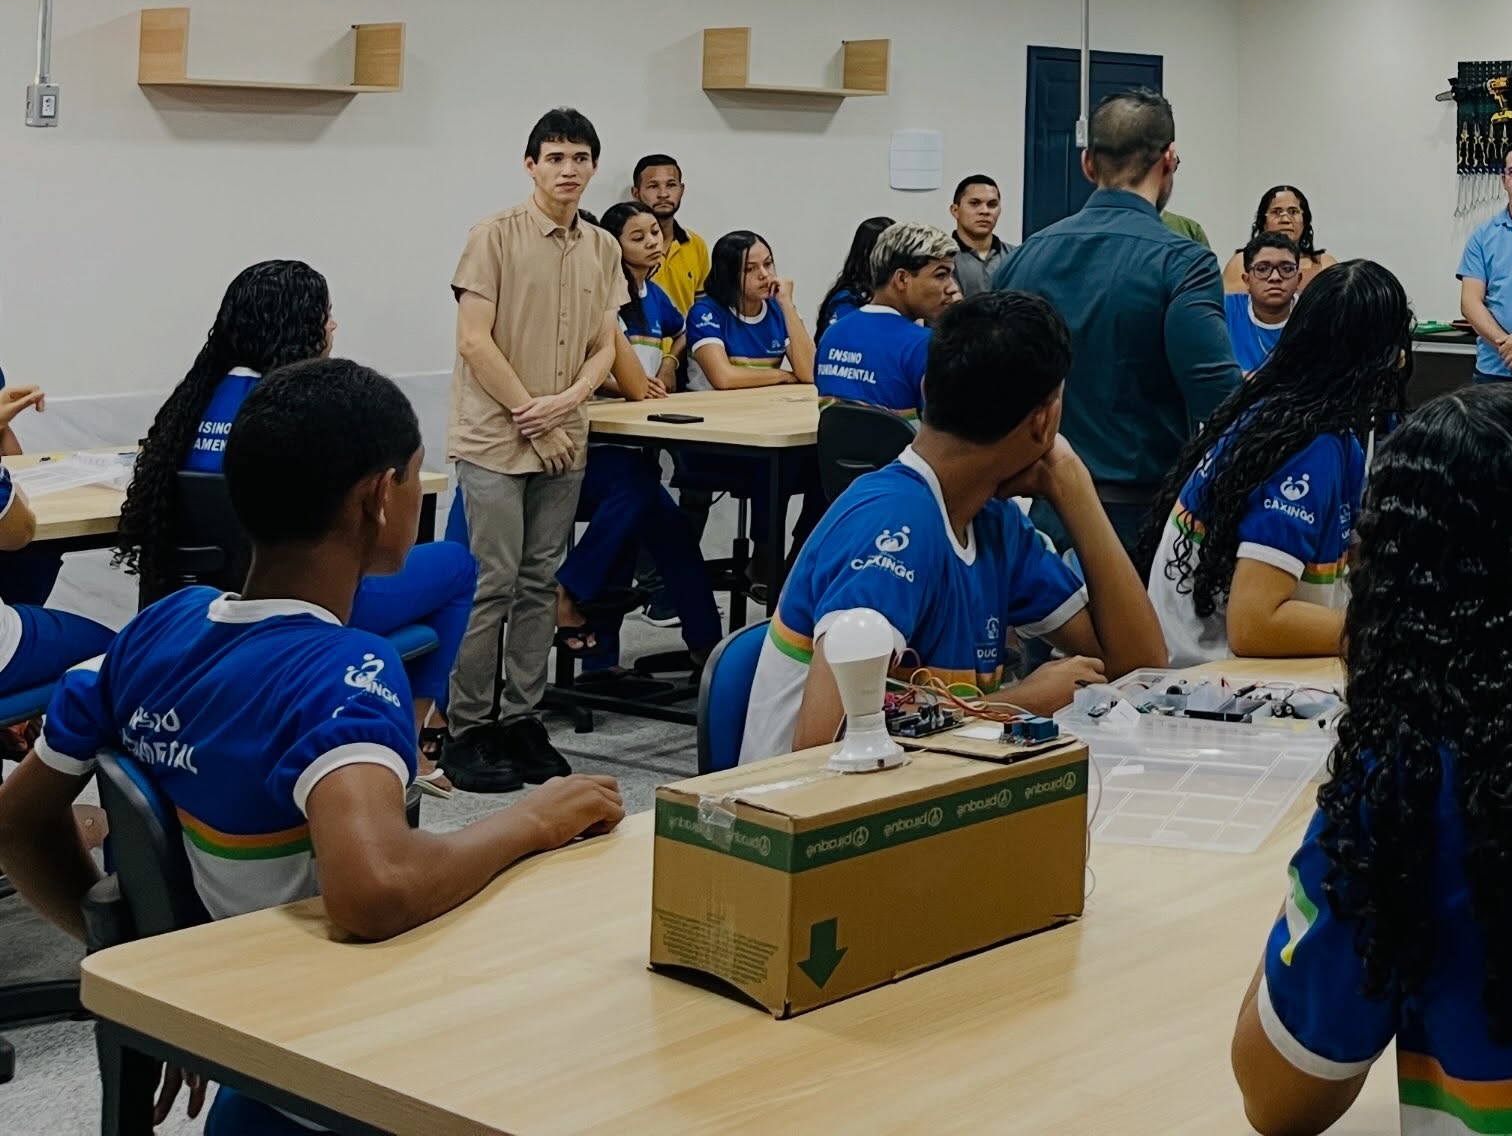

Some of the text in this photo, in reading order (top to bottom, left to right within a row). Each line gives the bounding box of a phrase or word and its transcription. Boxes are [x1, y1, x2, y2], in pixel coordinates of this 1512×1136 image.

[828, 348, 862, 365] ENSINO
[817, 363, 877, 385] FUNDAMENTAL
[1263, 498, 1315, 524] CAXINGÓ
